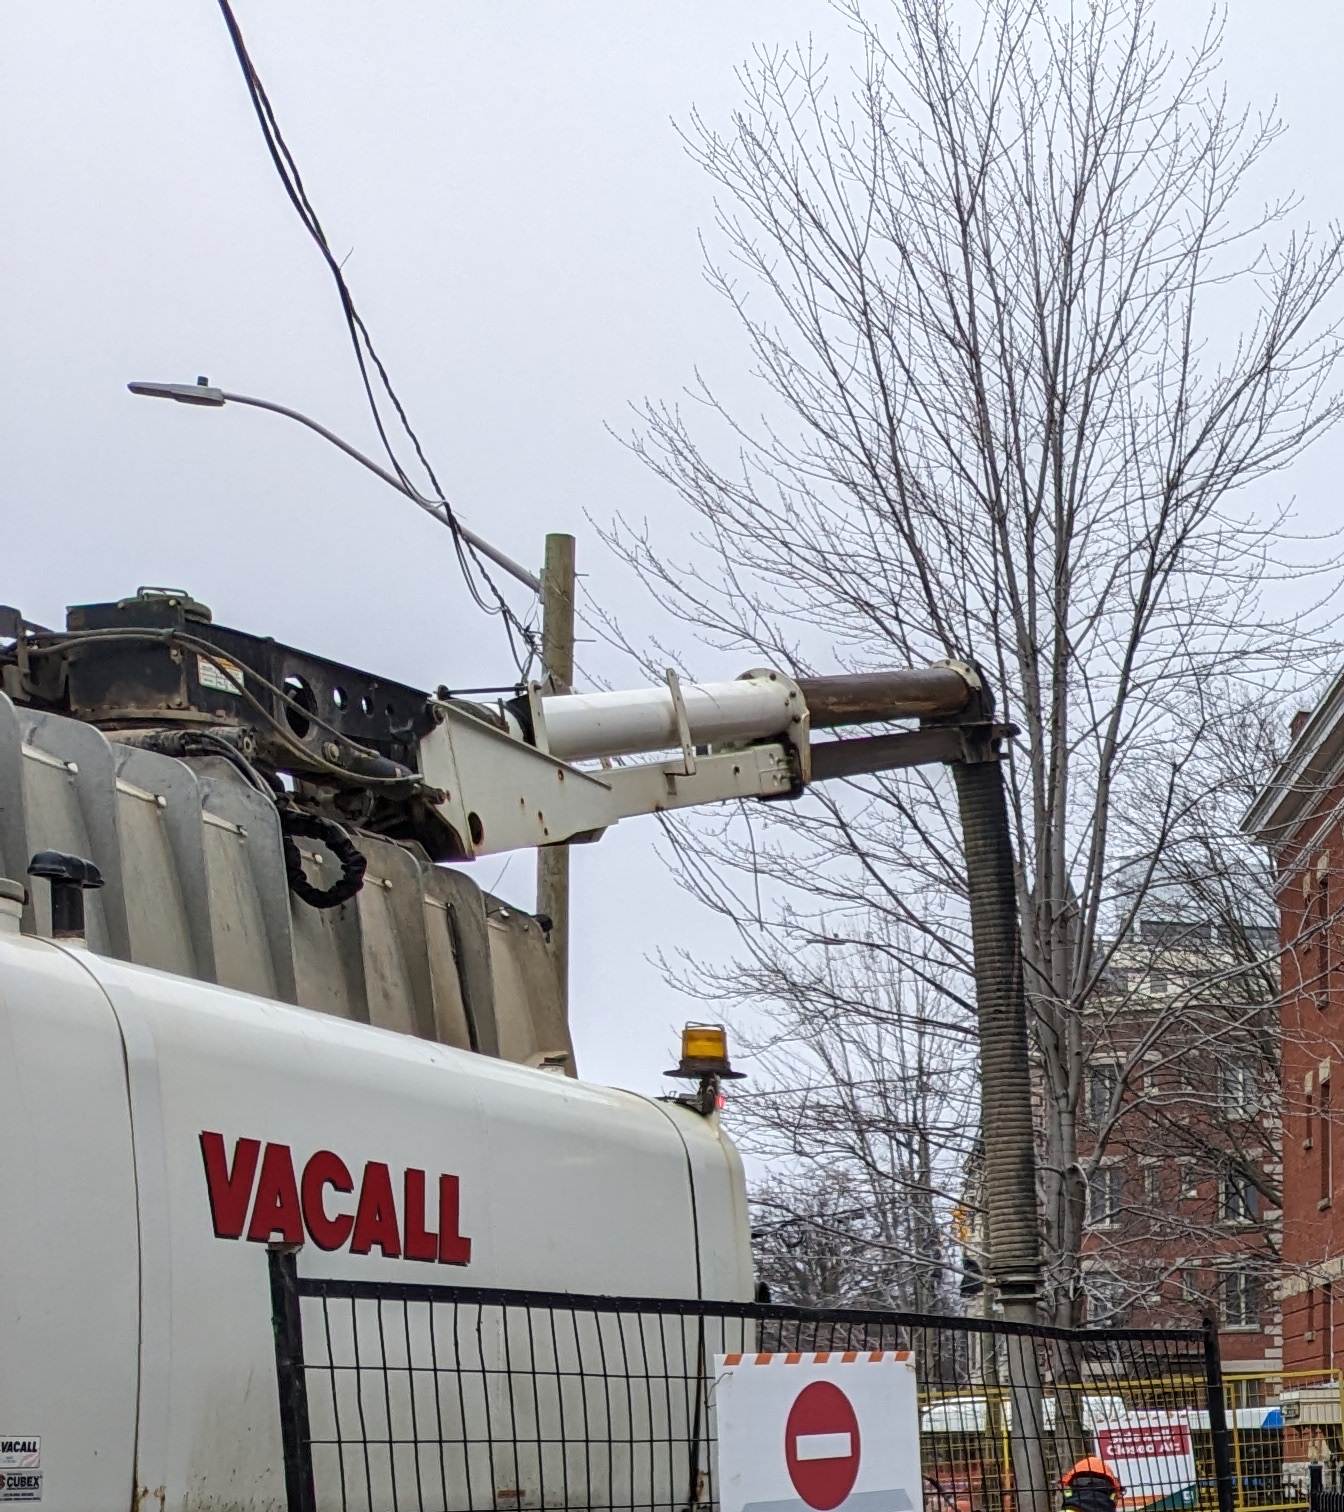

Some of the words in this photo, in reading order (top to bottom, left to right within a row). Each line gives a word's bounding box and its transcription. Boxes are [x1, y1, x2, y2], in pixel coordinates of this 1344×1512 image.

[199, 1130, 472, 1267] VACALL
[1, 1441, 38, 1453] VACALL
[1106, 1443, 1155, 1456] Closed
[6, 1475, 40, 1488] CUBEX
